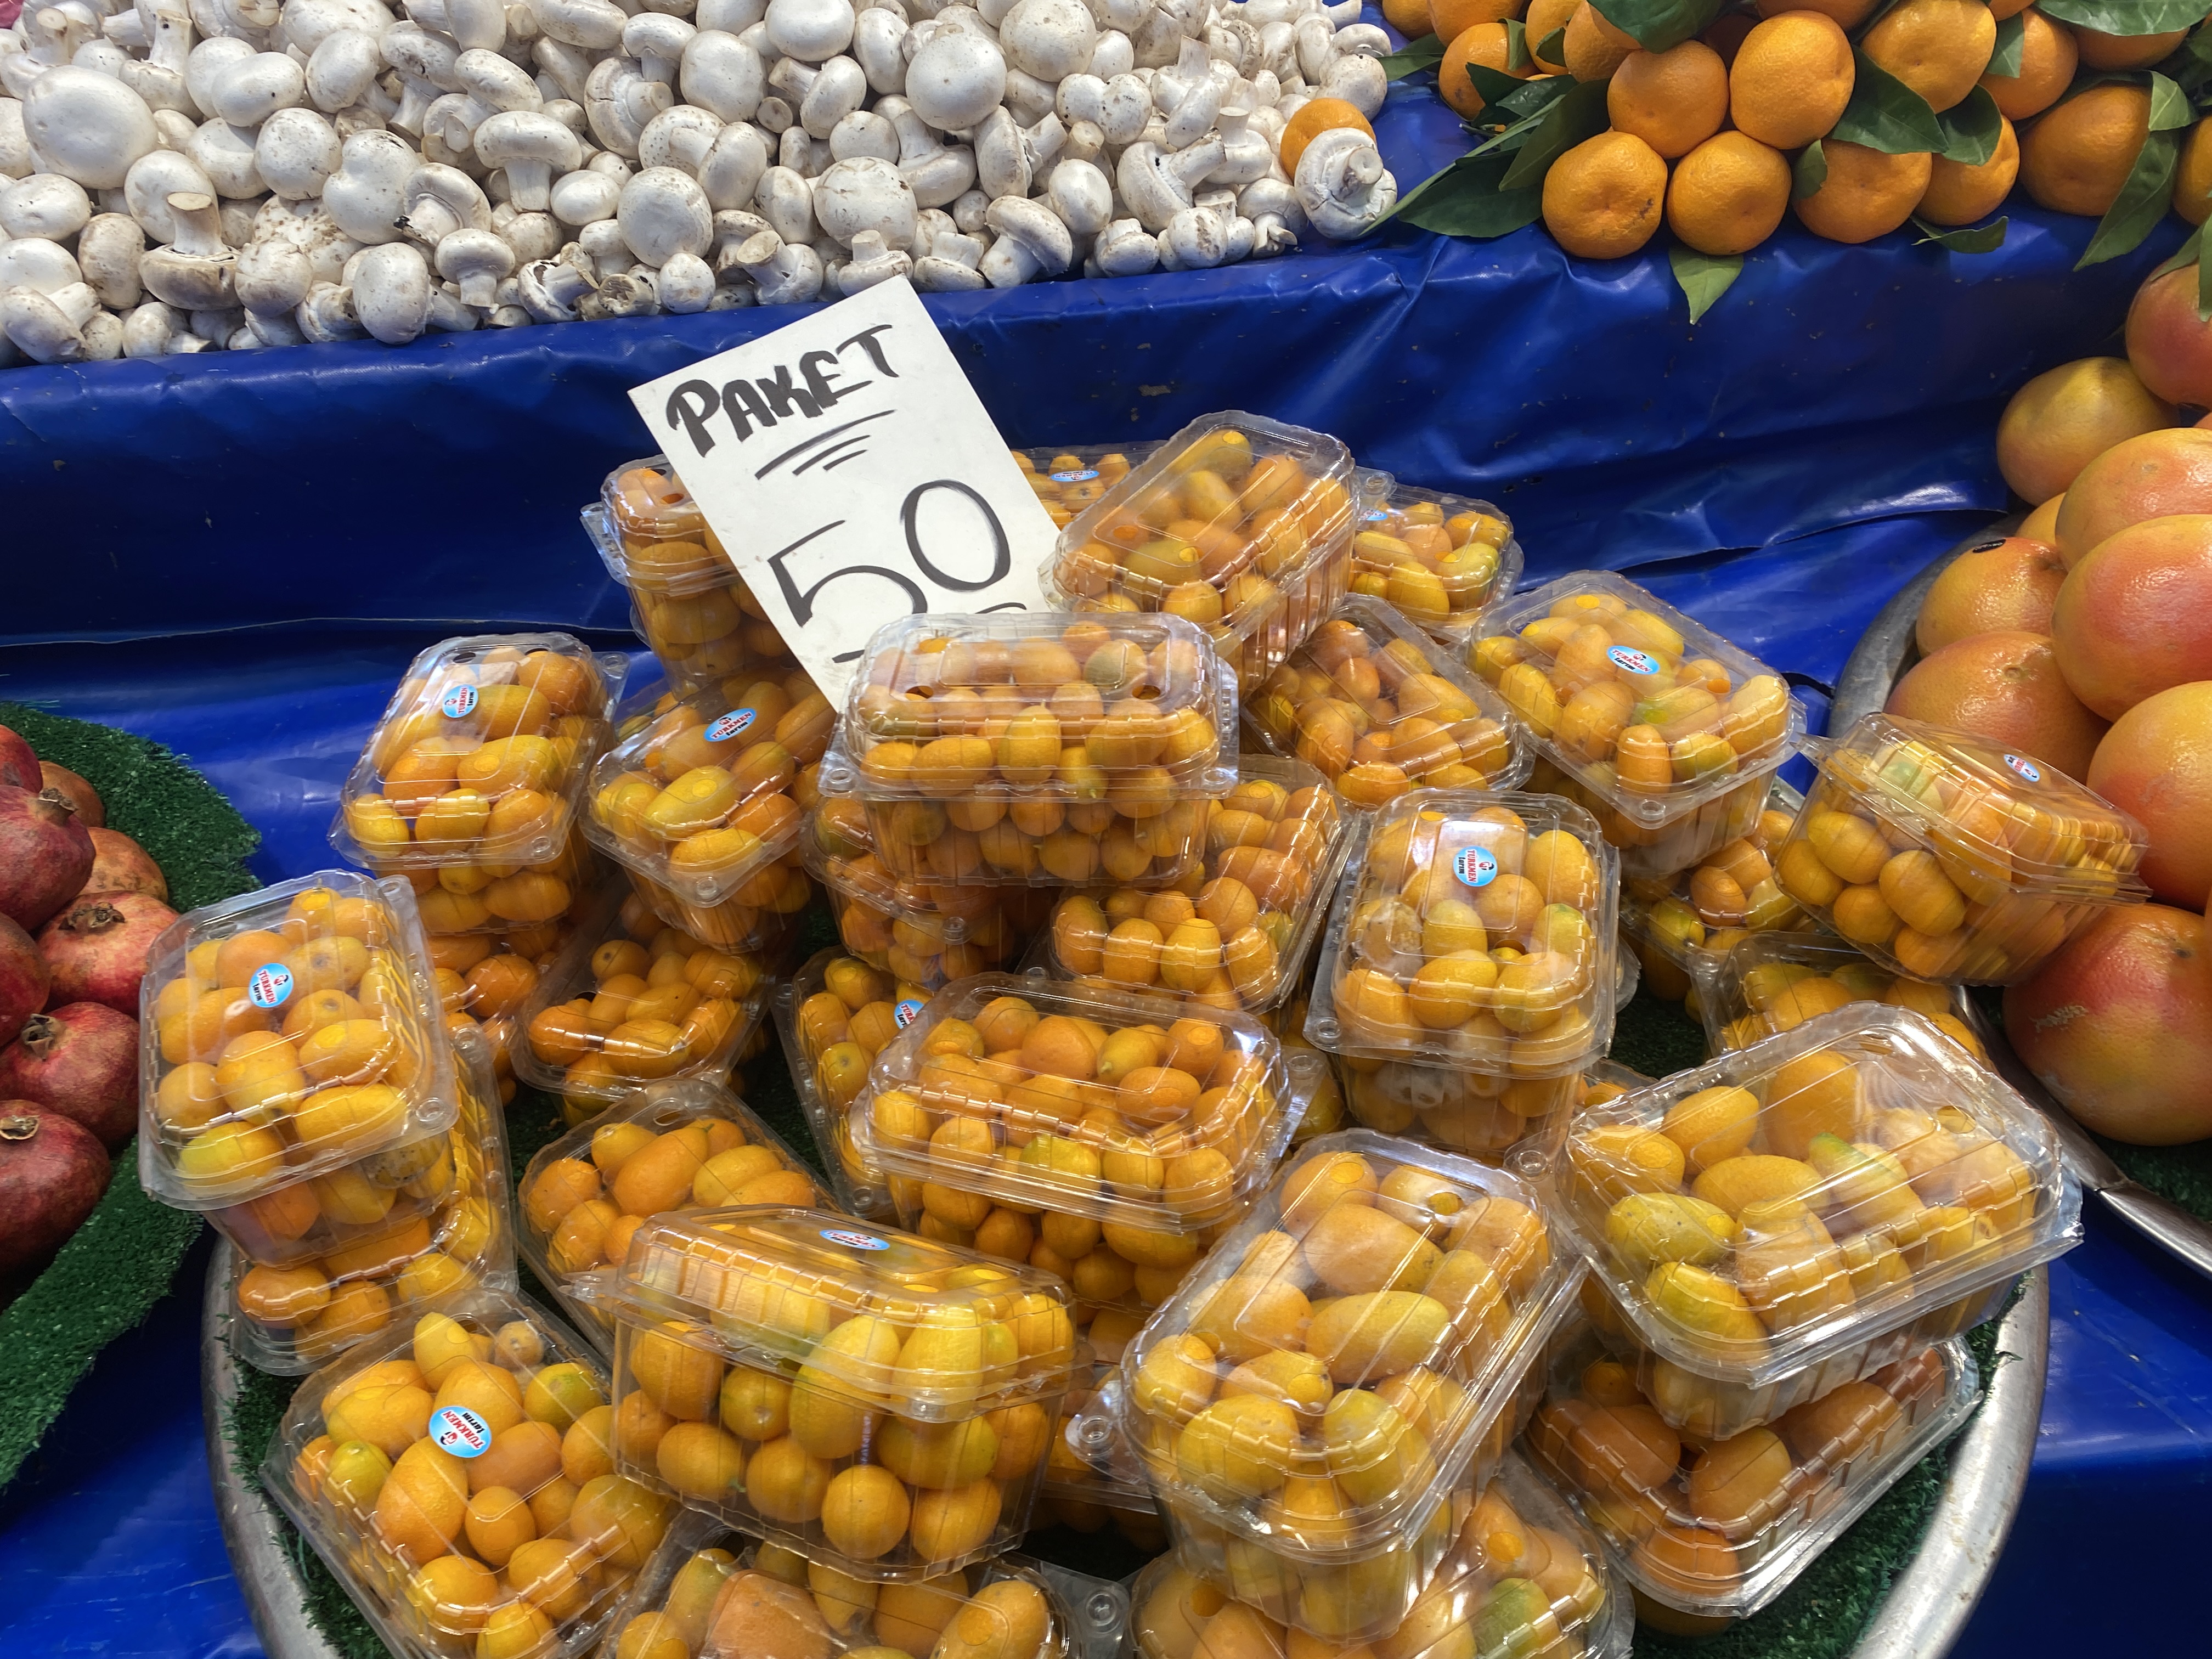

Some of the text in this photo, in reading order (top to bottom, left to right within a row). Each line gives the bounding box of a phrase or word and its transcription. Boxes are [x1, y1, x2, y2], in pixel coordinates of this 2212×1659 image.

[665, 324, 900, 458] PAKET
[768, 479, 1011, 663] 50
[1612, 650, 1651, 672] TÜRKMEN
[712, 712, 752, 738] TÜRKMEN
[725, 721, 748, 736] tarım
[1467, 850, 1477, 882] TÜRKMEN
[259, 970, 275, 1003] TÜRKMEN
[897, 1014, 908, 1025] tarı
[901, 1004, 916, 1022] TÜRK
[827, 1232, 879, 1248] TÜRKMEN
[443, 1411, 484, 1448] TÜRKMEN
[461, 1413, 485, 1434] tarım
